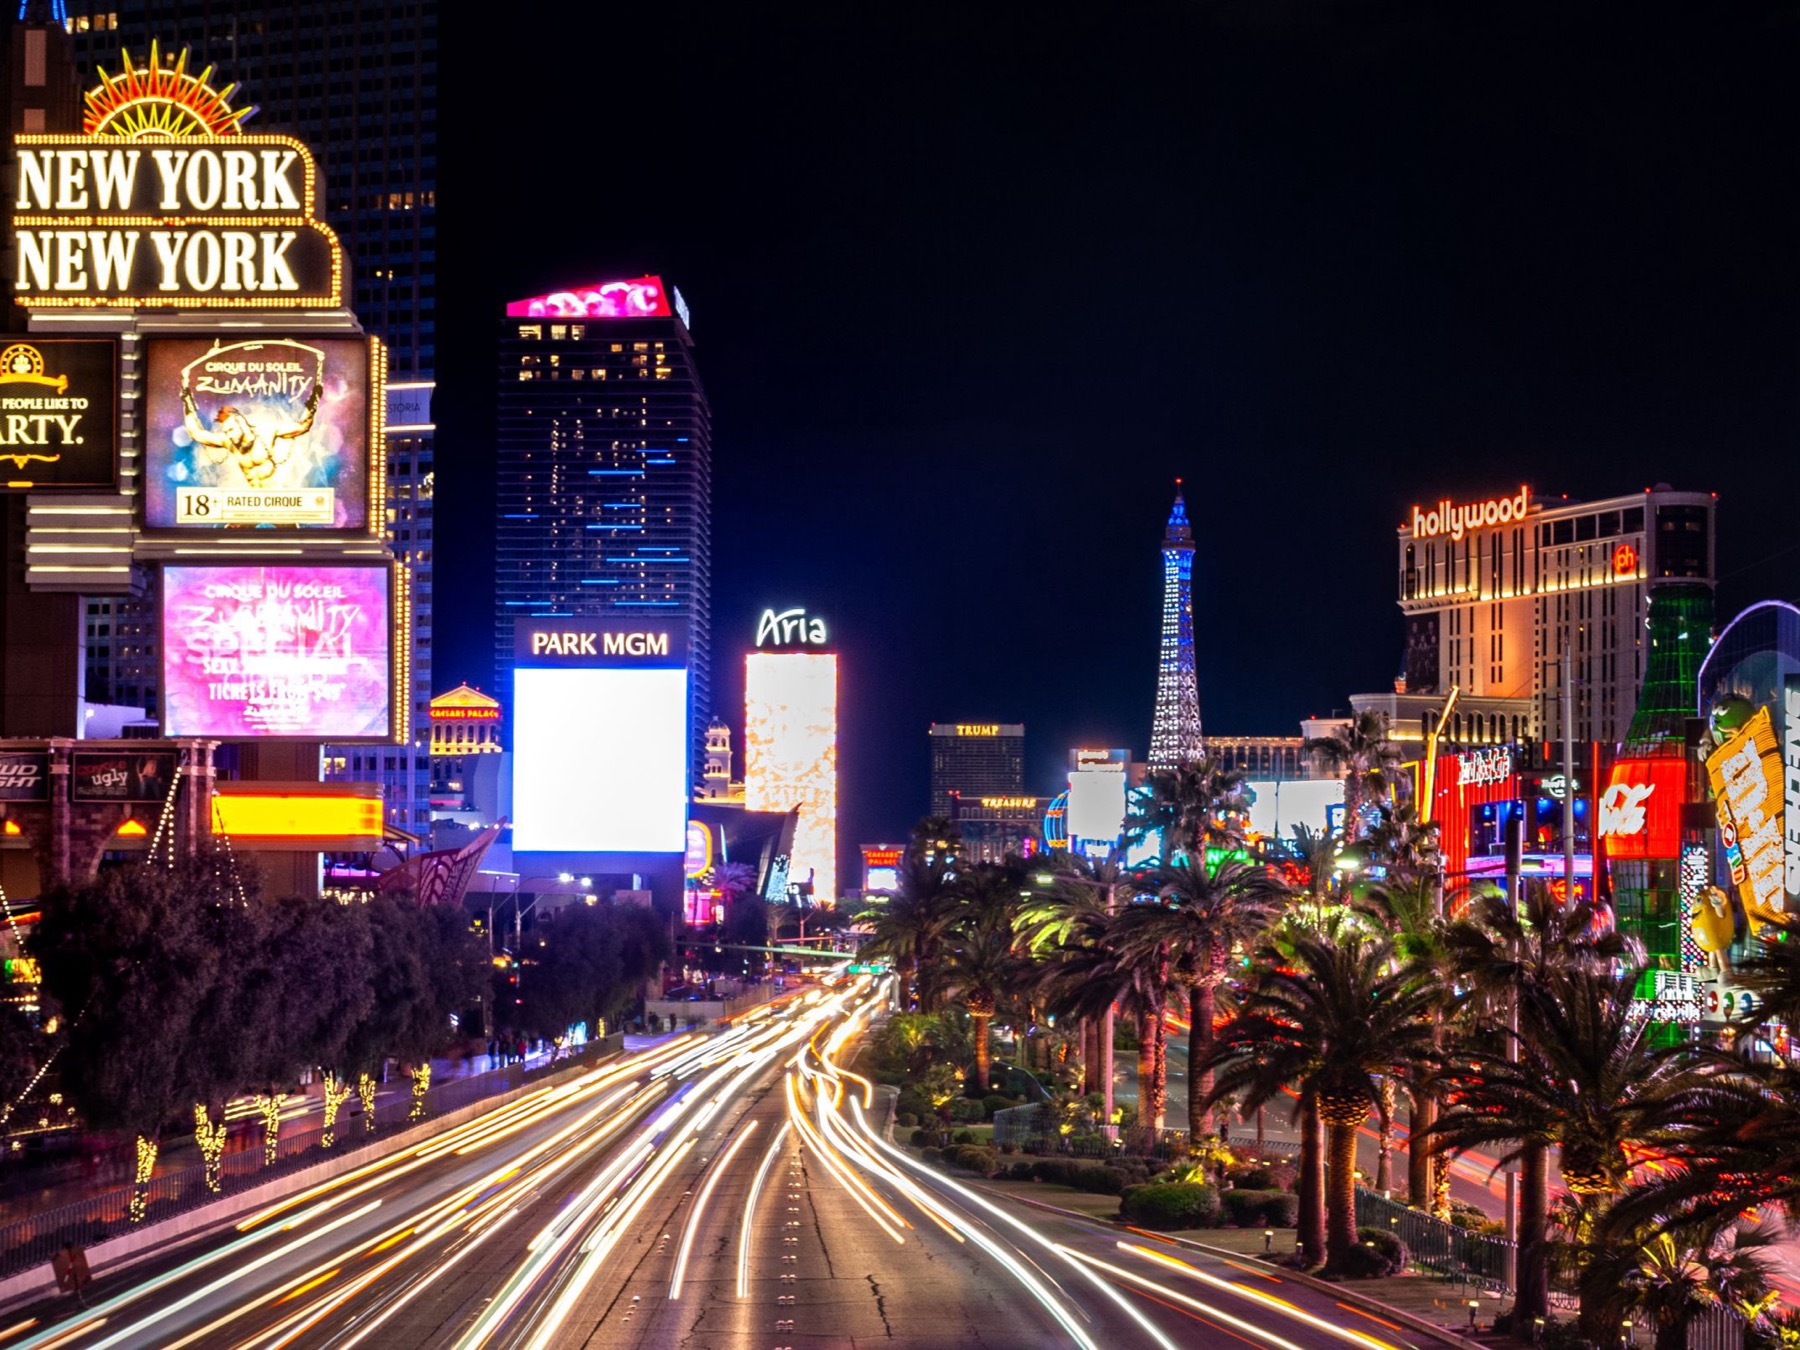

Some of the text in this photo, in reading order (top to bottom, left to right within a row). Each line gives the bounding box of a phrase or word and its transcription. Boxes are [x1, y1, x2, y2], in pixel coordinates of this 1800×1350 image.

[16, 149, 300, 210] NEW YORK
[15, 230, 299, 291] NEW YORK
[205, 362, 304, 374] CIRQUE DU SOLEIL
[196, 372, 313, 403] ZUMANITY
[2, 398, 88, 409] PEOPLE LIKE TO
[0, 415, 84, 444] RTY.
[227, 496, 261, 507] RATED
[264, 496, 303, 507] CIRQUE
[1413, 485, 1527, 541] hollywood
[204, 584, 347, 601] CIRQUE DU SOLEIL
[756, 608, 827, 647] Aria
[533, 632, 668, 655] PARK MGM
[956, 725, 999, 736] TRUMP
[0, 764, 38, 775] UD
[91, 768, 128, 787] ugly
[981, 798, 1037, 808] TREASURE
